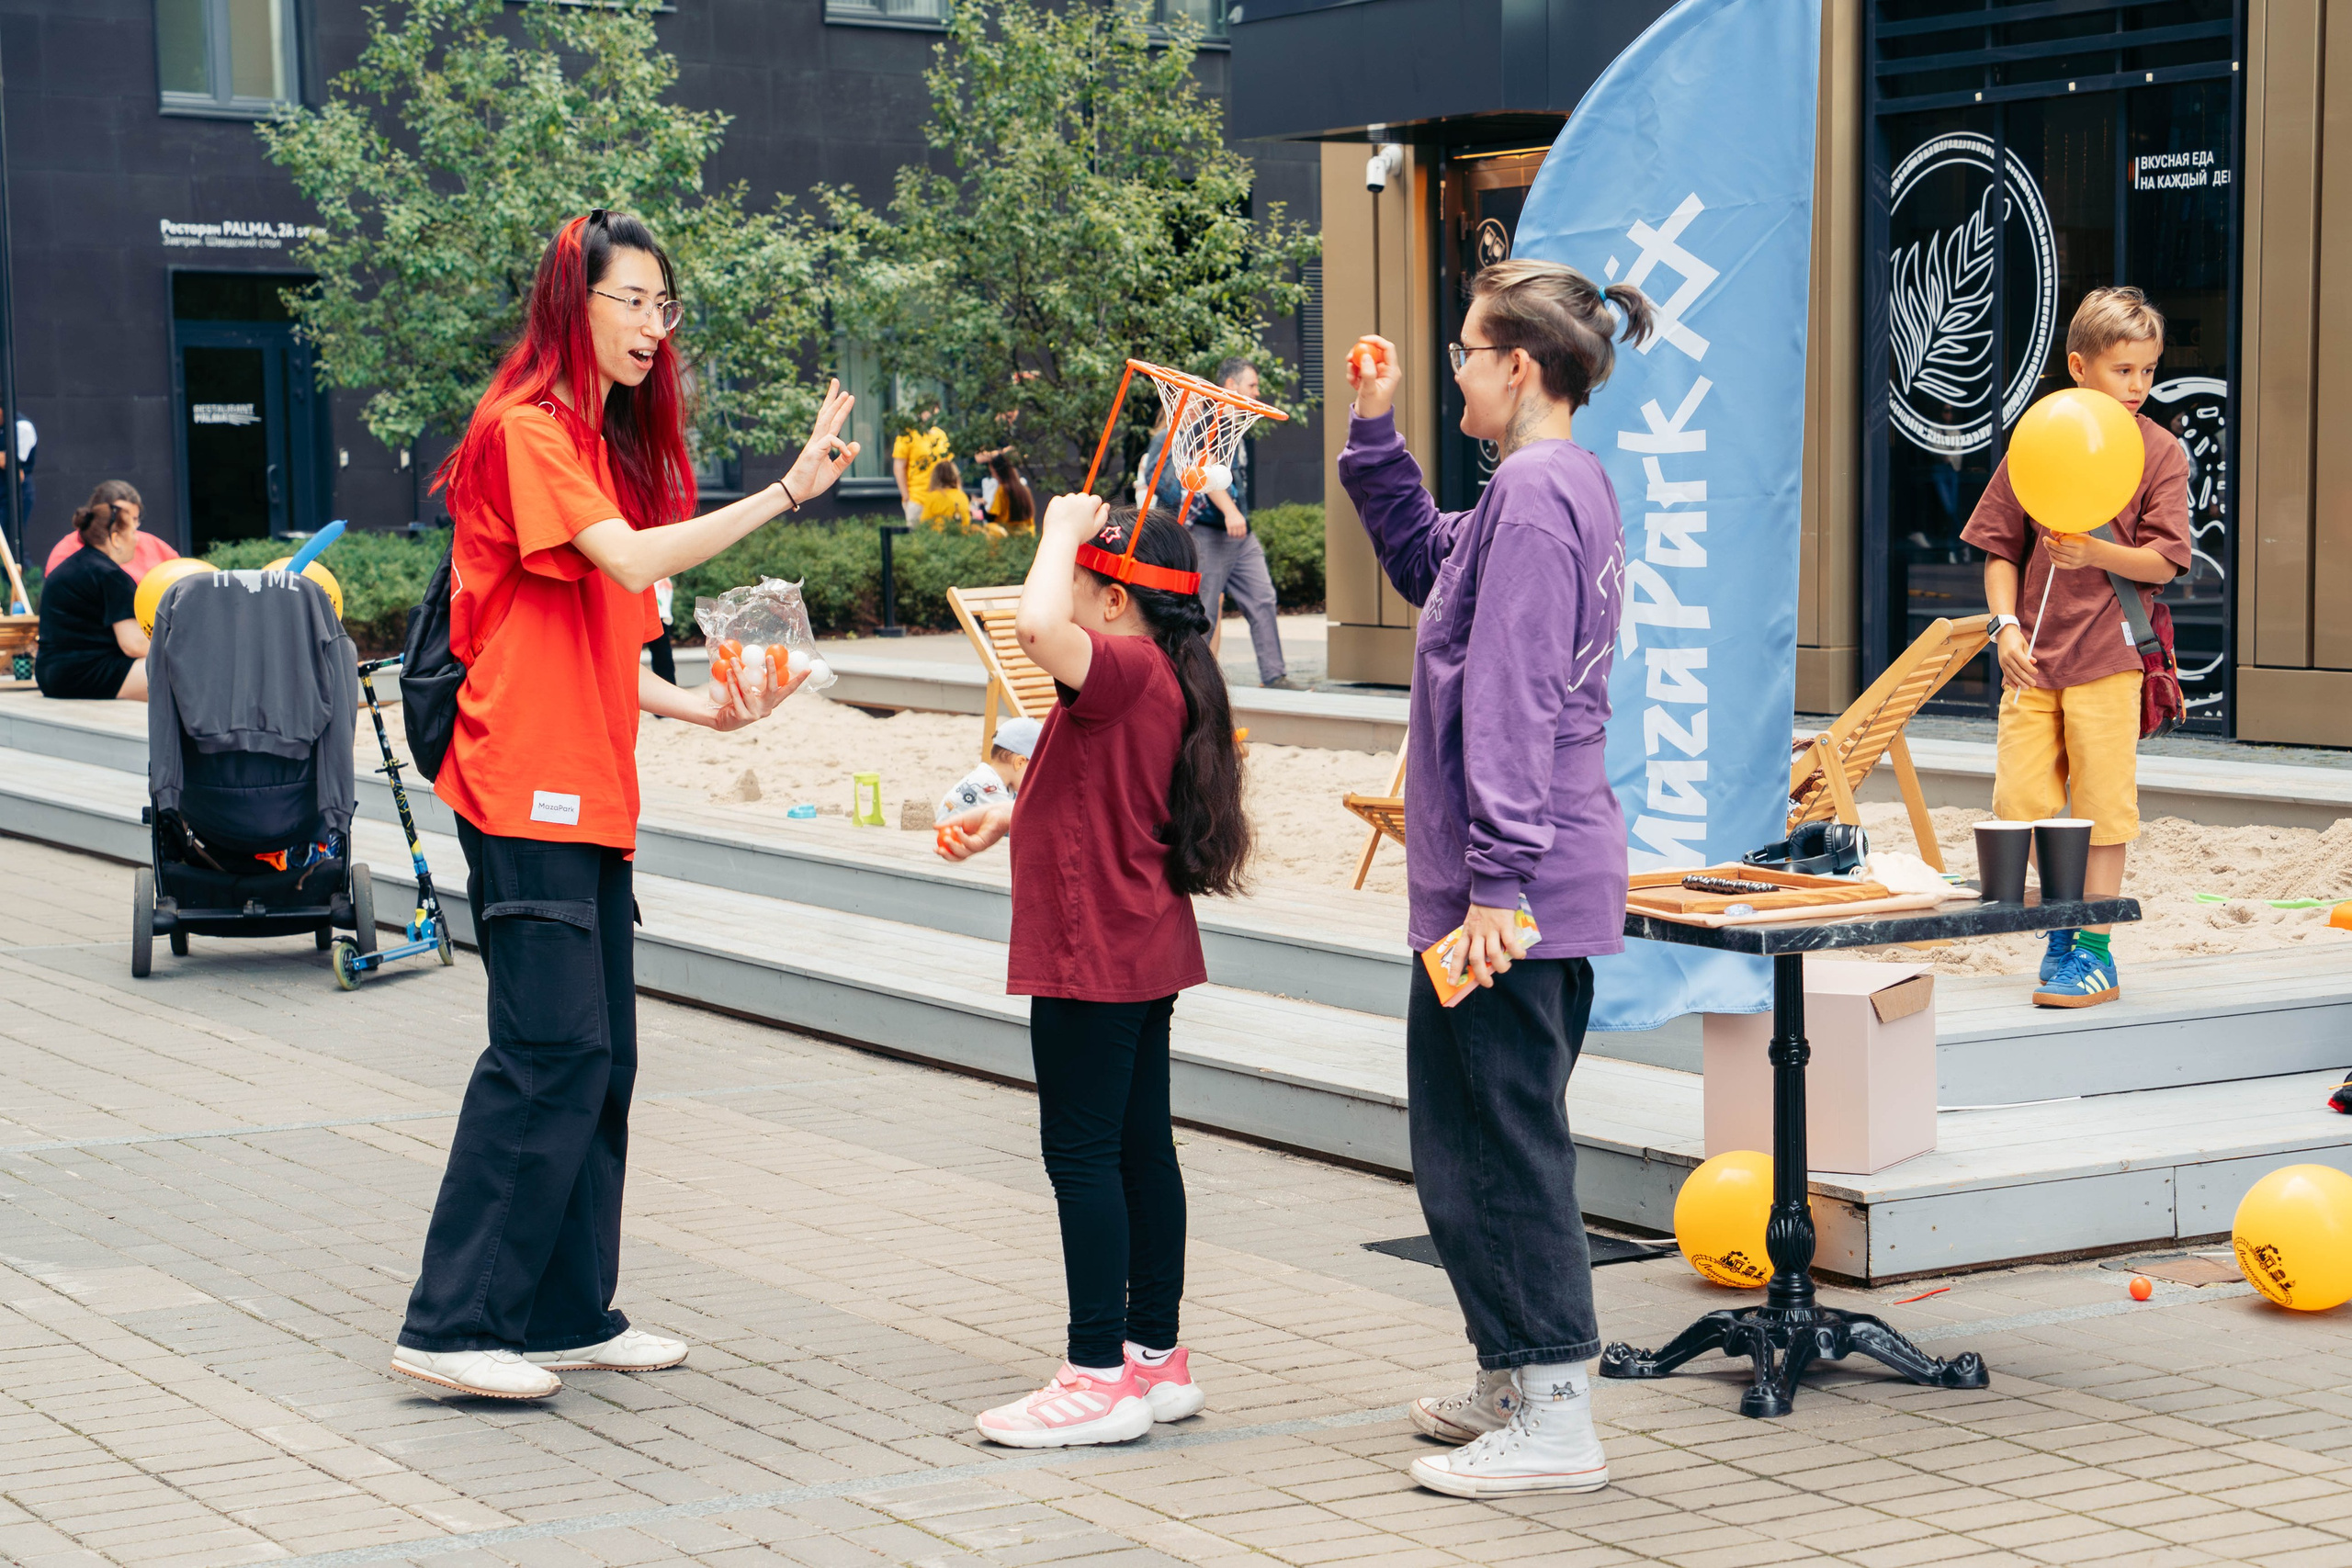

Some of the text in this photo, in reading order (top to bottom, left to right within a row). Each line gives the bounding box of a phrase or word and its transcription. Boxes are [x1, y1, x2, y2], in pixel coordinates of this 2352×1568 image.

[2141, 151, 2214, 170] ВКУСНАЯ ЕДА
[2140, 176, 2155, 190] НА
[2157, 169, 2207, 189] КАЖДЫЙ
[160, 219, 221, 237] Ресторан
[1617, 375, 1712, 869] MazaPark
[538, 802, 575, 813] MazaPark
